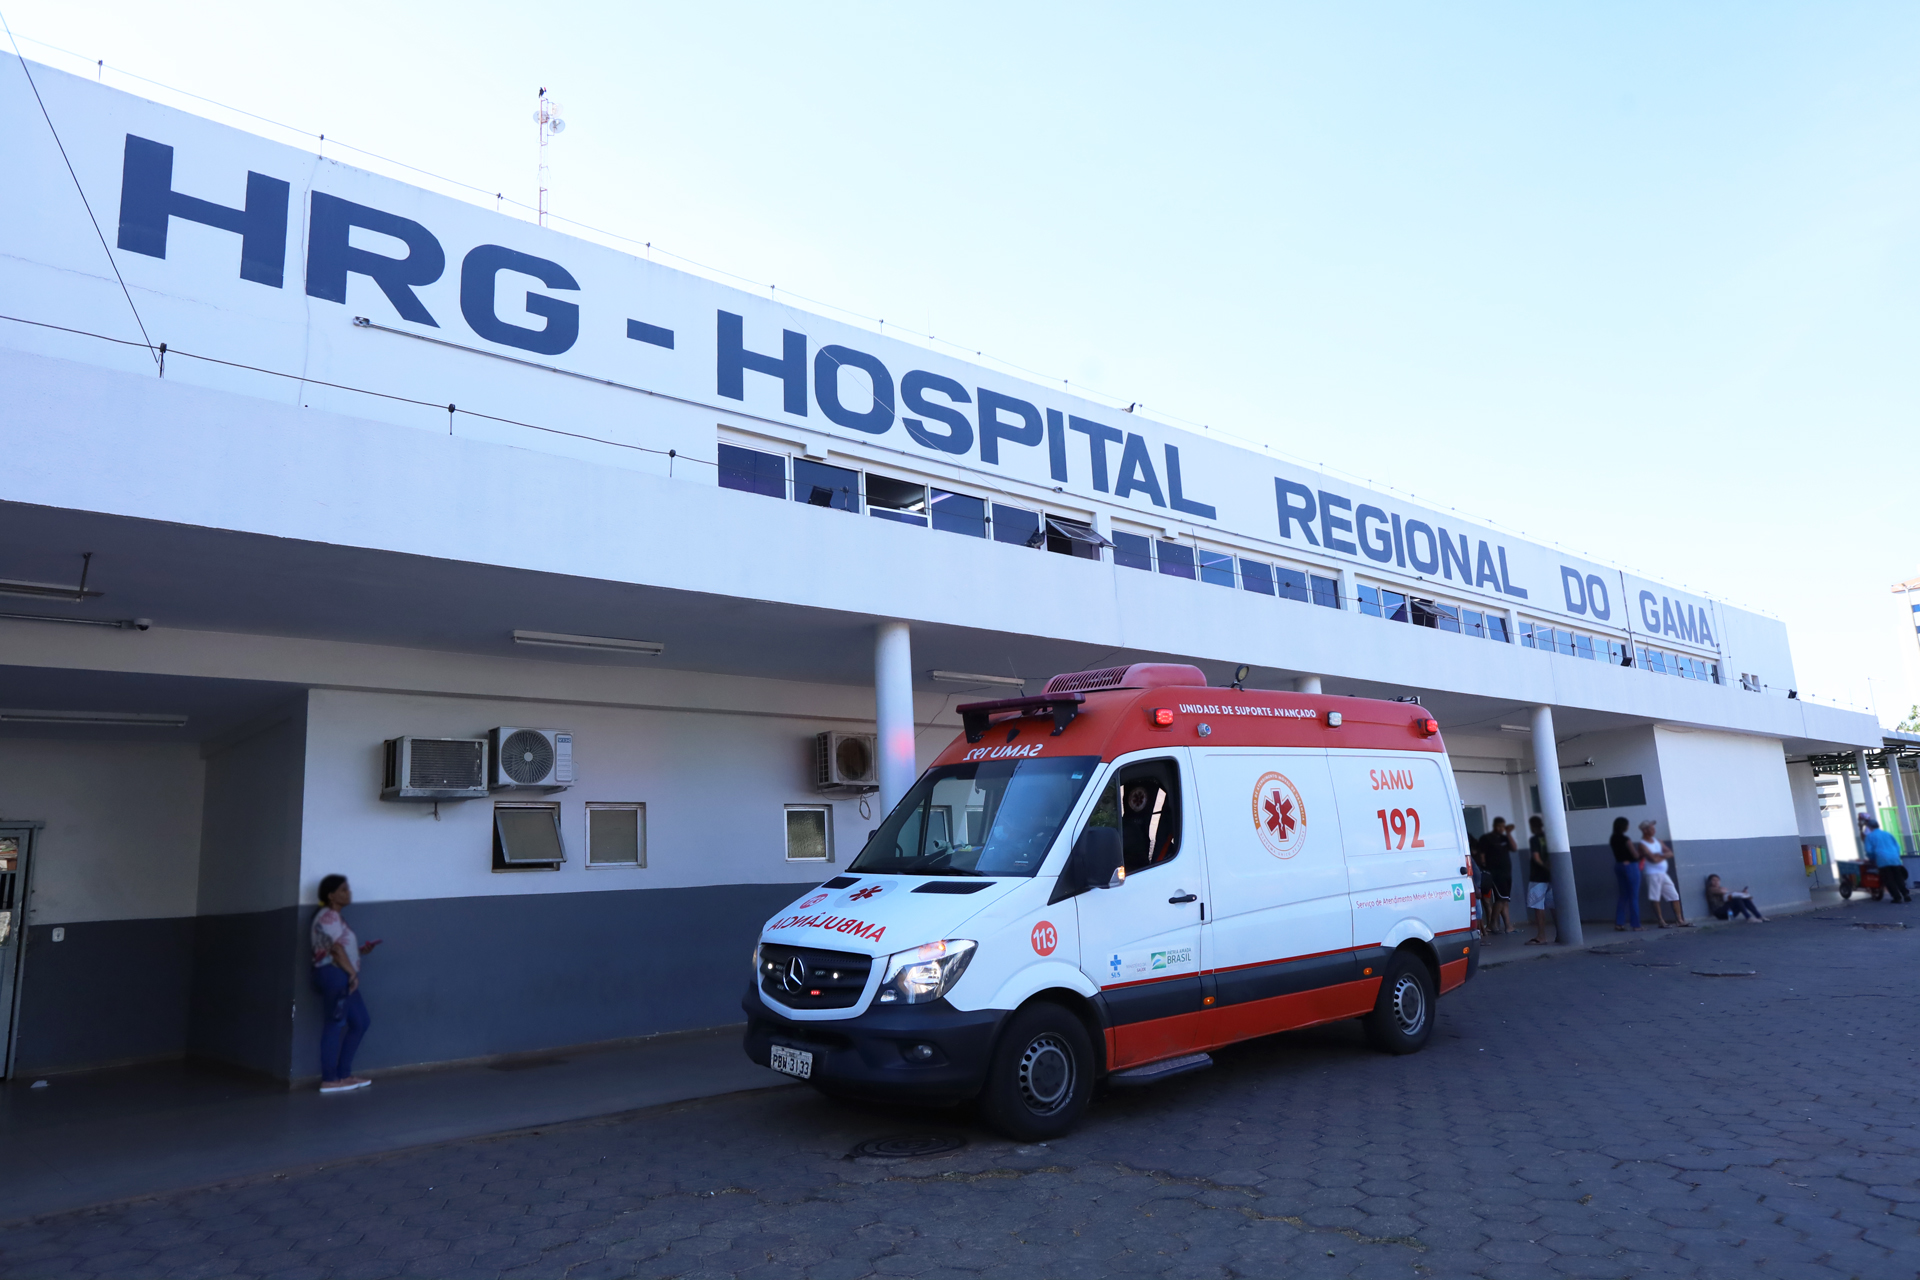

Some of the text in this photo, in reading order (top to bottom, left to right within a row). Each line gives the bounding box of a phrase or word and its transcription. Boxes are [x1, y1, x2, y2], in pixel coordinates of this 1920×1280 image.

[117, 133, 581, 355] HRG
[717, 309, 1216, 520] HOSPITAL
[1273, 476, 1528, 599] REGIONAL
[1560, 564, 1611, 621] DO
[1638, 589, 1716, 648] GAMA
[1179, 703, 1317, 720] UNIDADE DE SUPORTE AVANÇADO
[1369, 769, 1414, 791] SAMU
[1377, 807, 1425, 851] 192
[1356, 900, 1375, 909] Serviço
[1375, 898, 1382, 906] de
[1383, 895, 1413, 905] Atendimento
[1413, 891, 1427, 900] Móvel
[1427, 891, 1433, 899] de
[1033, 927, 1056, 950] 113
[1167, 953, 1191, 964] BRASIL
